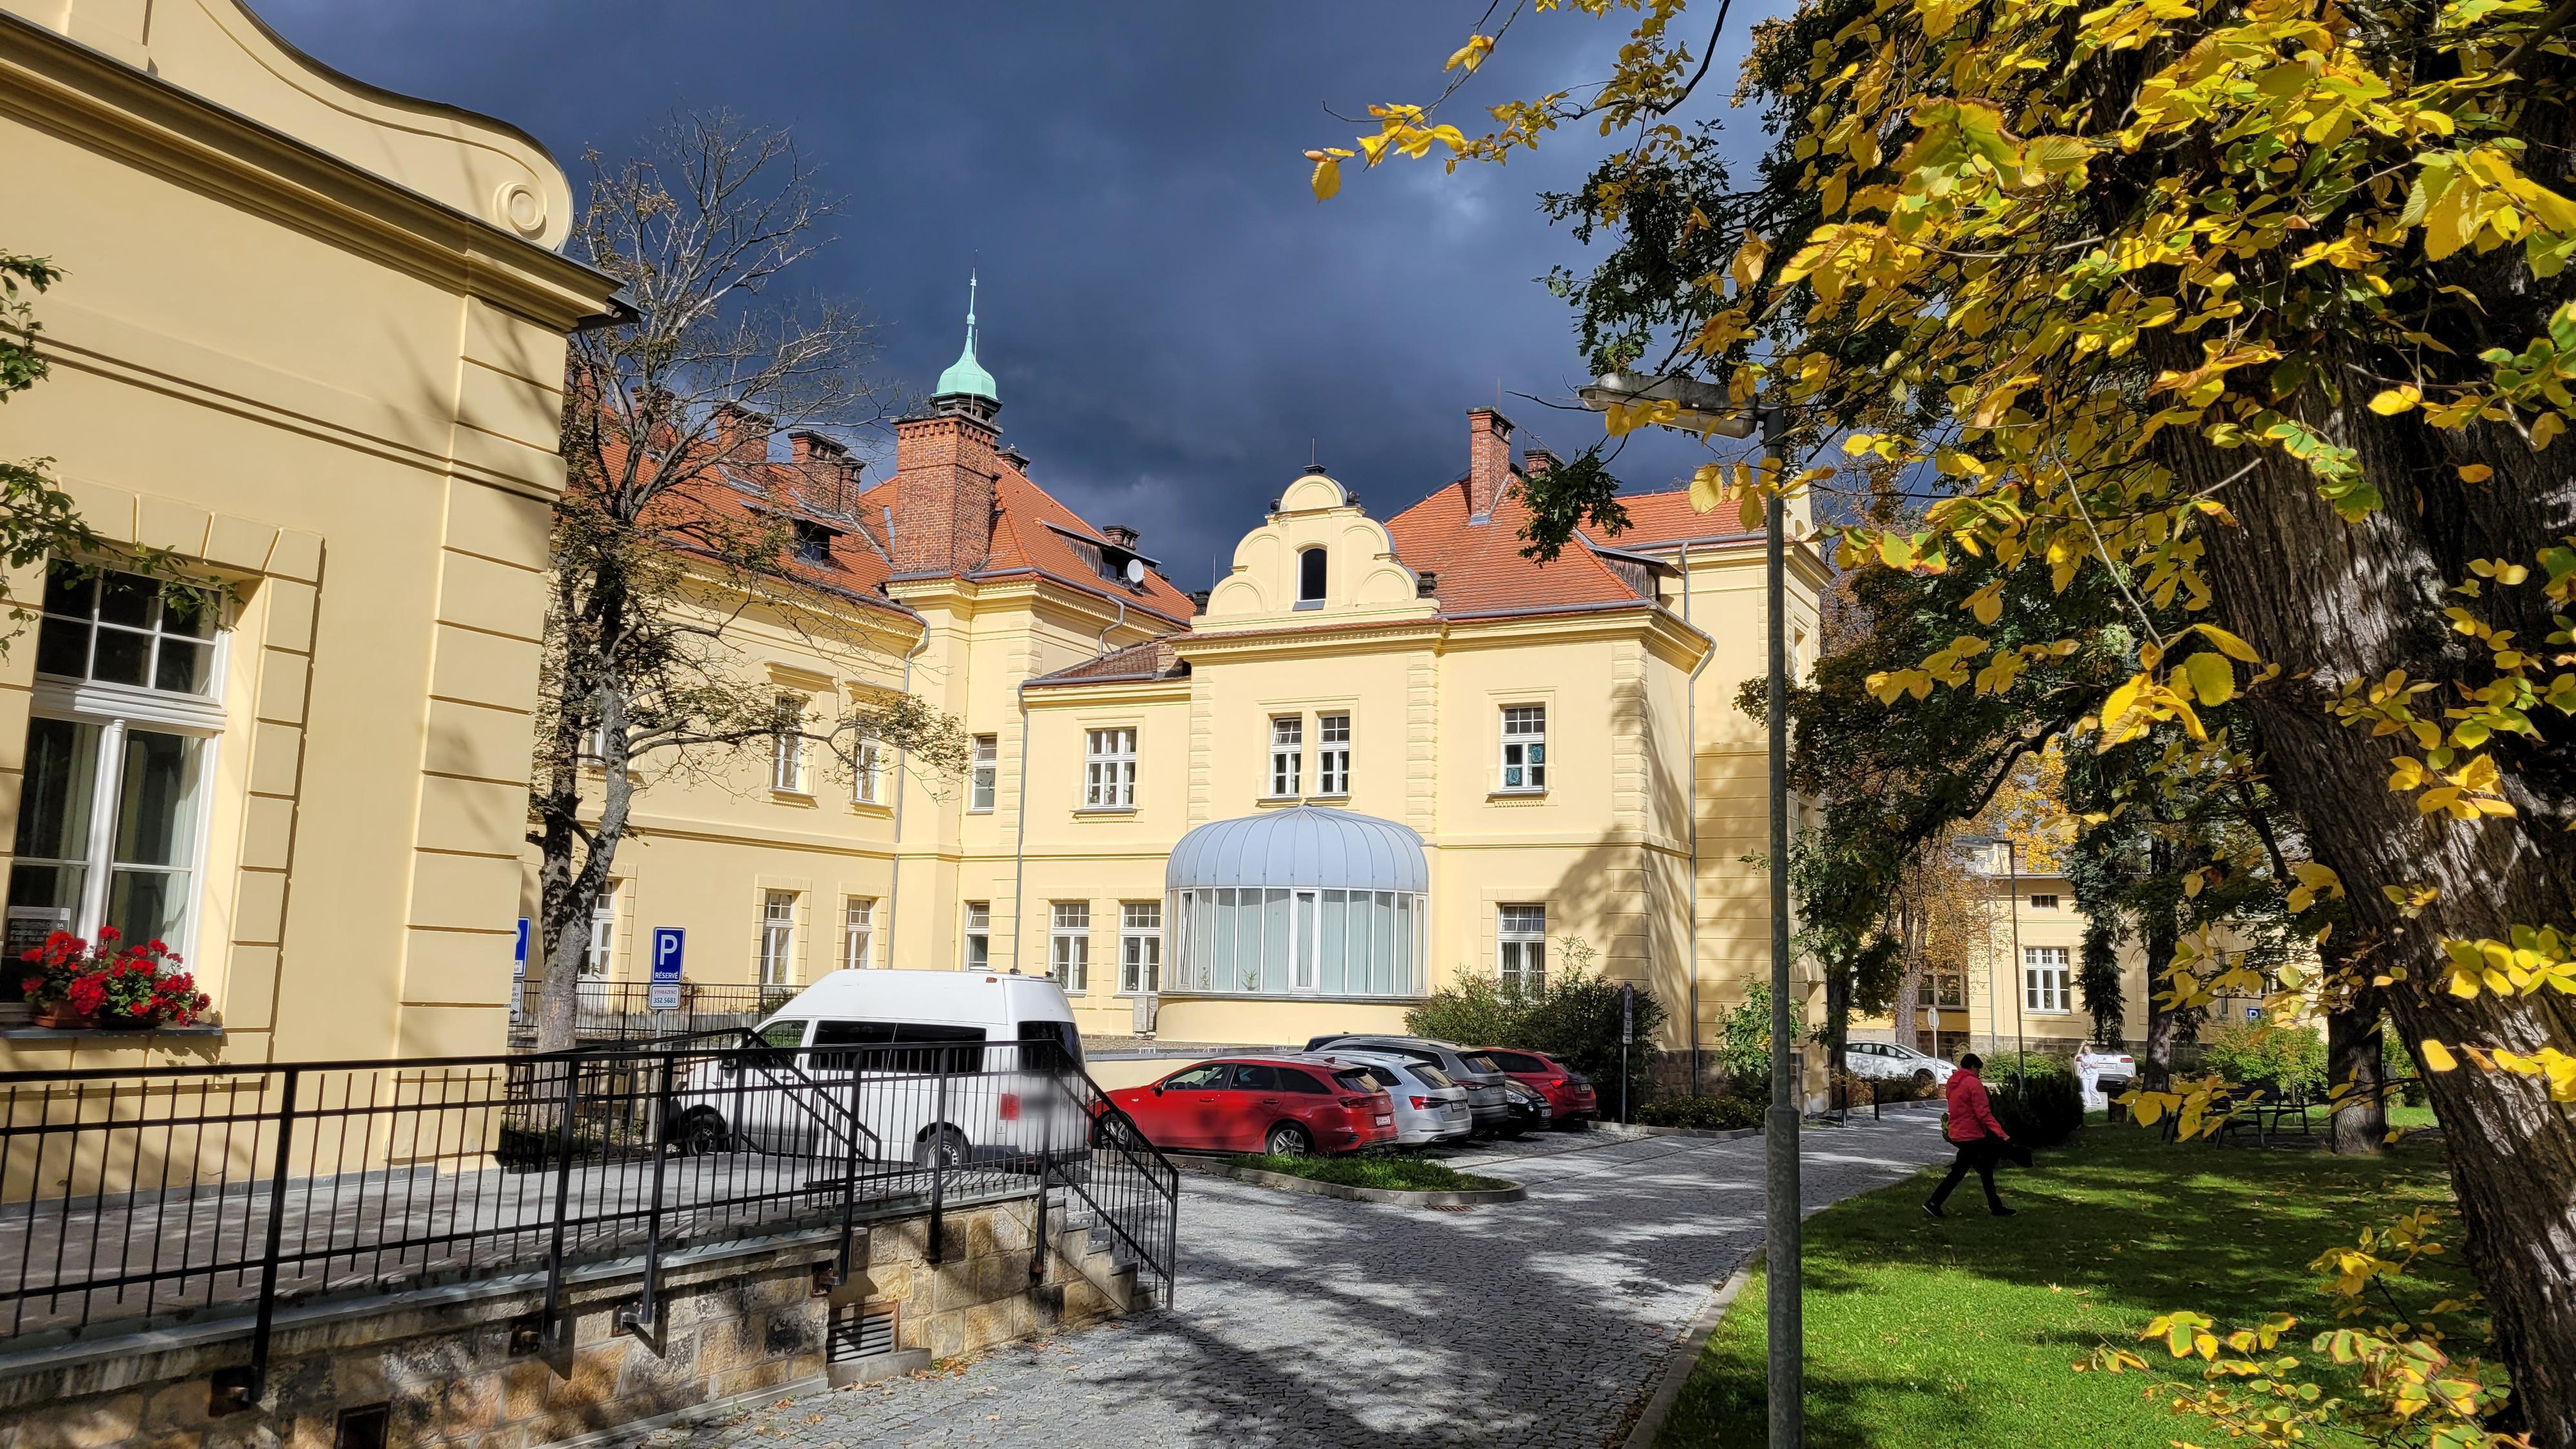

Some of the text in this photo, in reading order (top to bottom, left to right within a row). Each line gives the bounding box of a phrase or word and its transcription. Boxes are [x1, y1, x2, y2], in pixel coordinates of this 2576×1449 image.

[659, 934, 678, 965] P
[1626, 987, 1631, 1007] P
[2249, 1010, 2259, 1023] P
